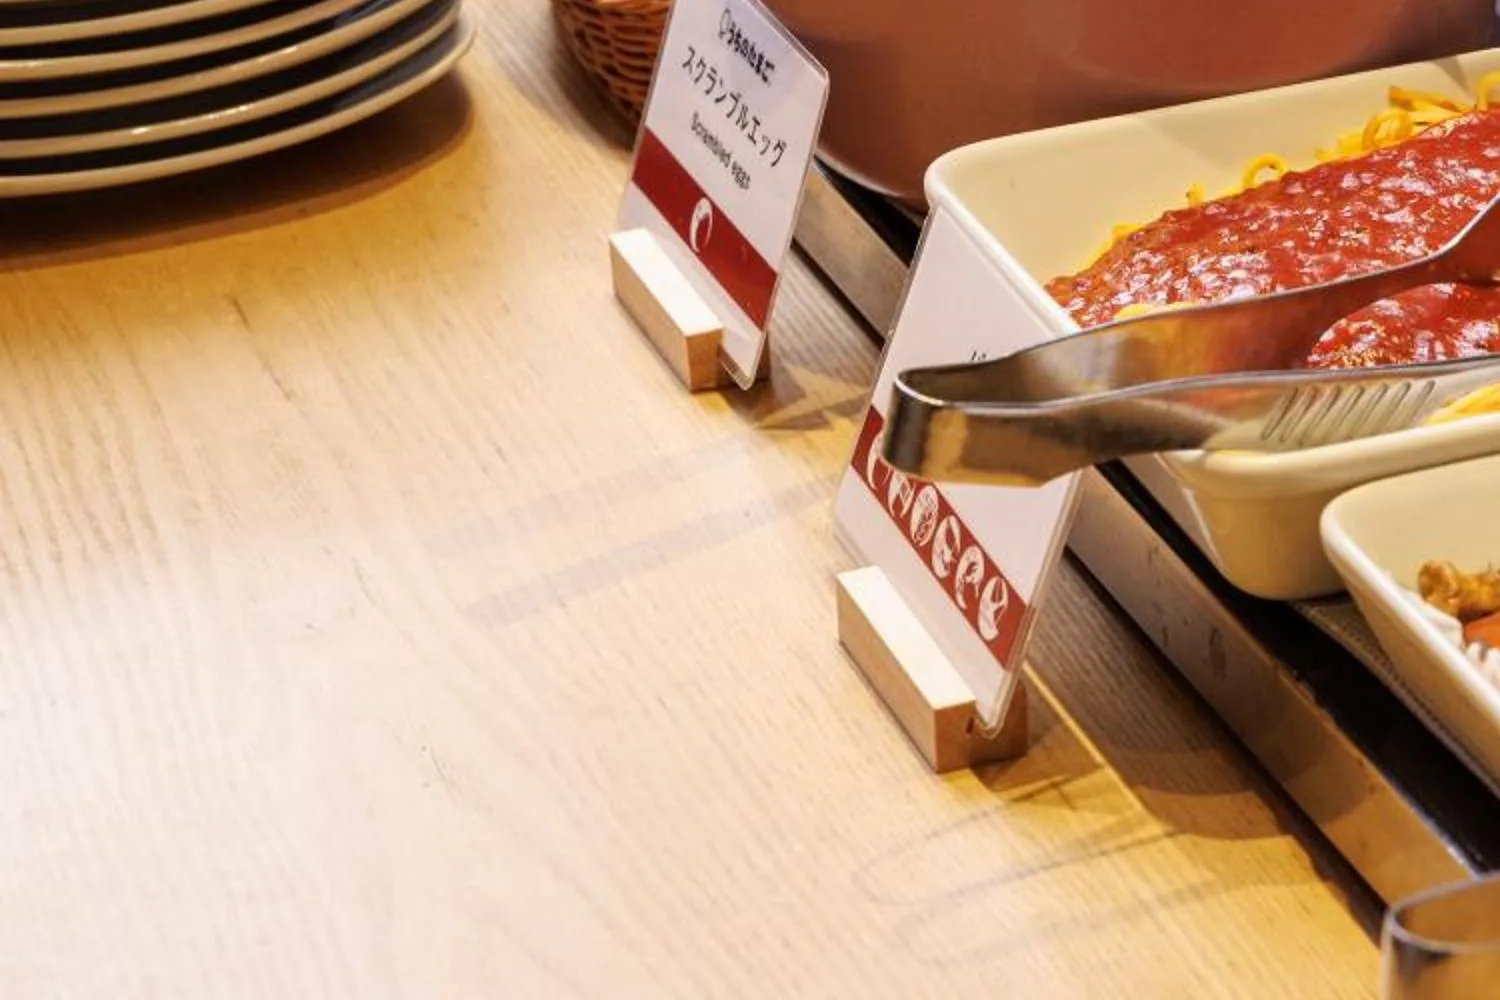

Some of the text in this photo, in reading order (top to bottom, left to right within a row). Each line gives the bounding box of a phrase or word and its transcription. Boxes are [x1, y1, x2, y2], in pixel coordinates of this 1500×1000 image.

[682, 45, 787, 168] スクランブルエッグ
